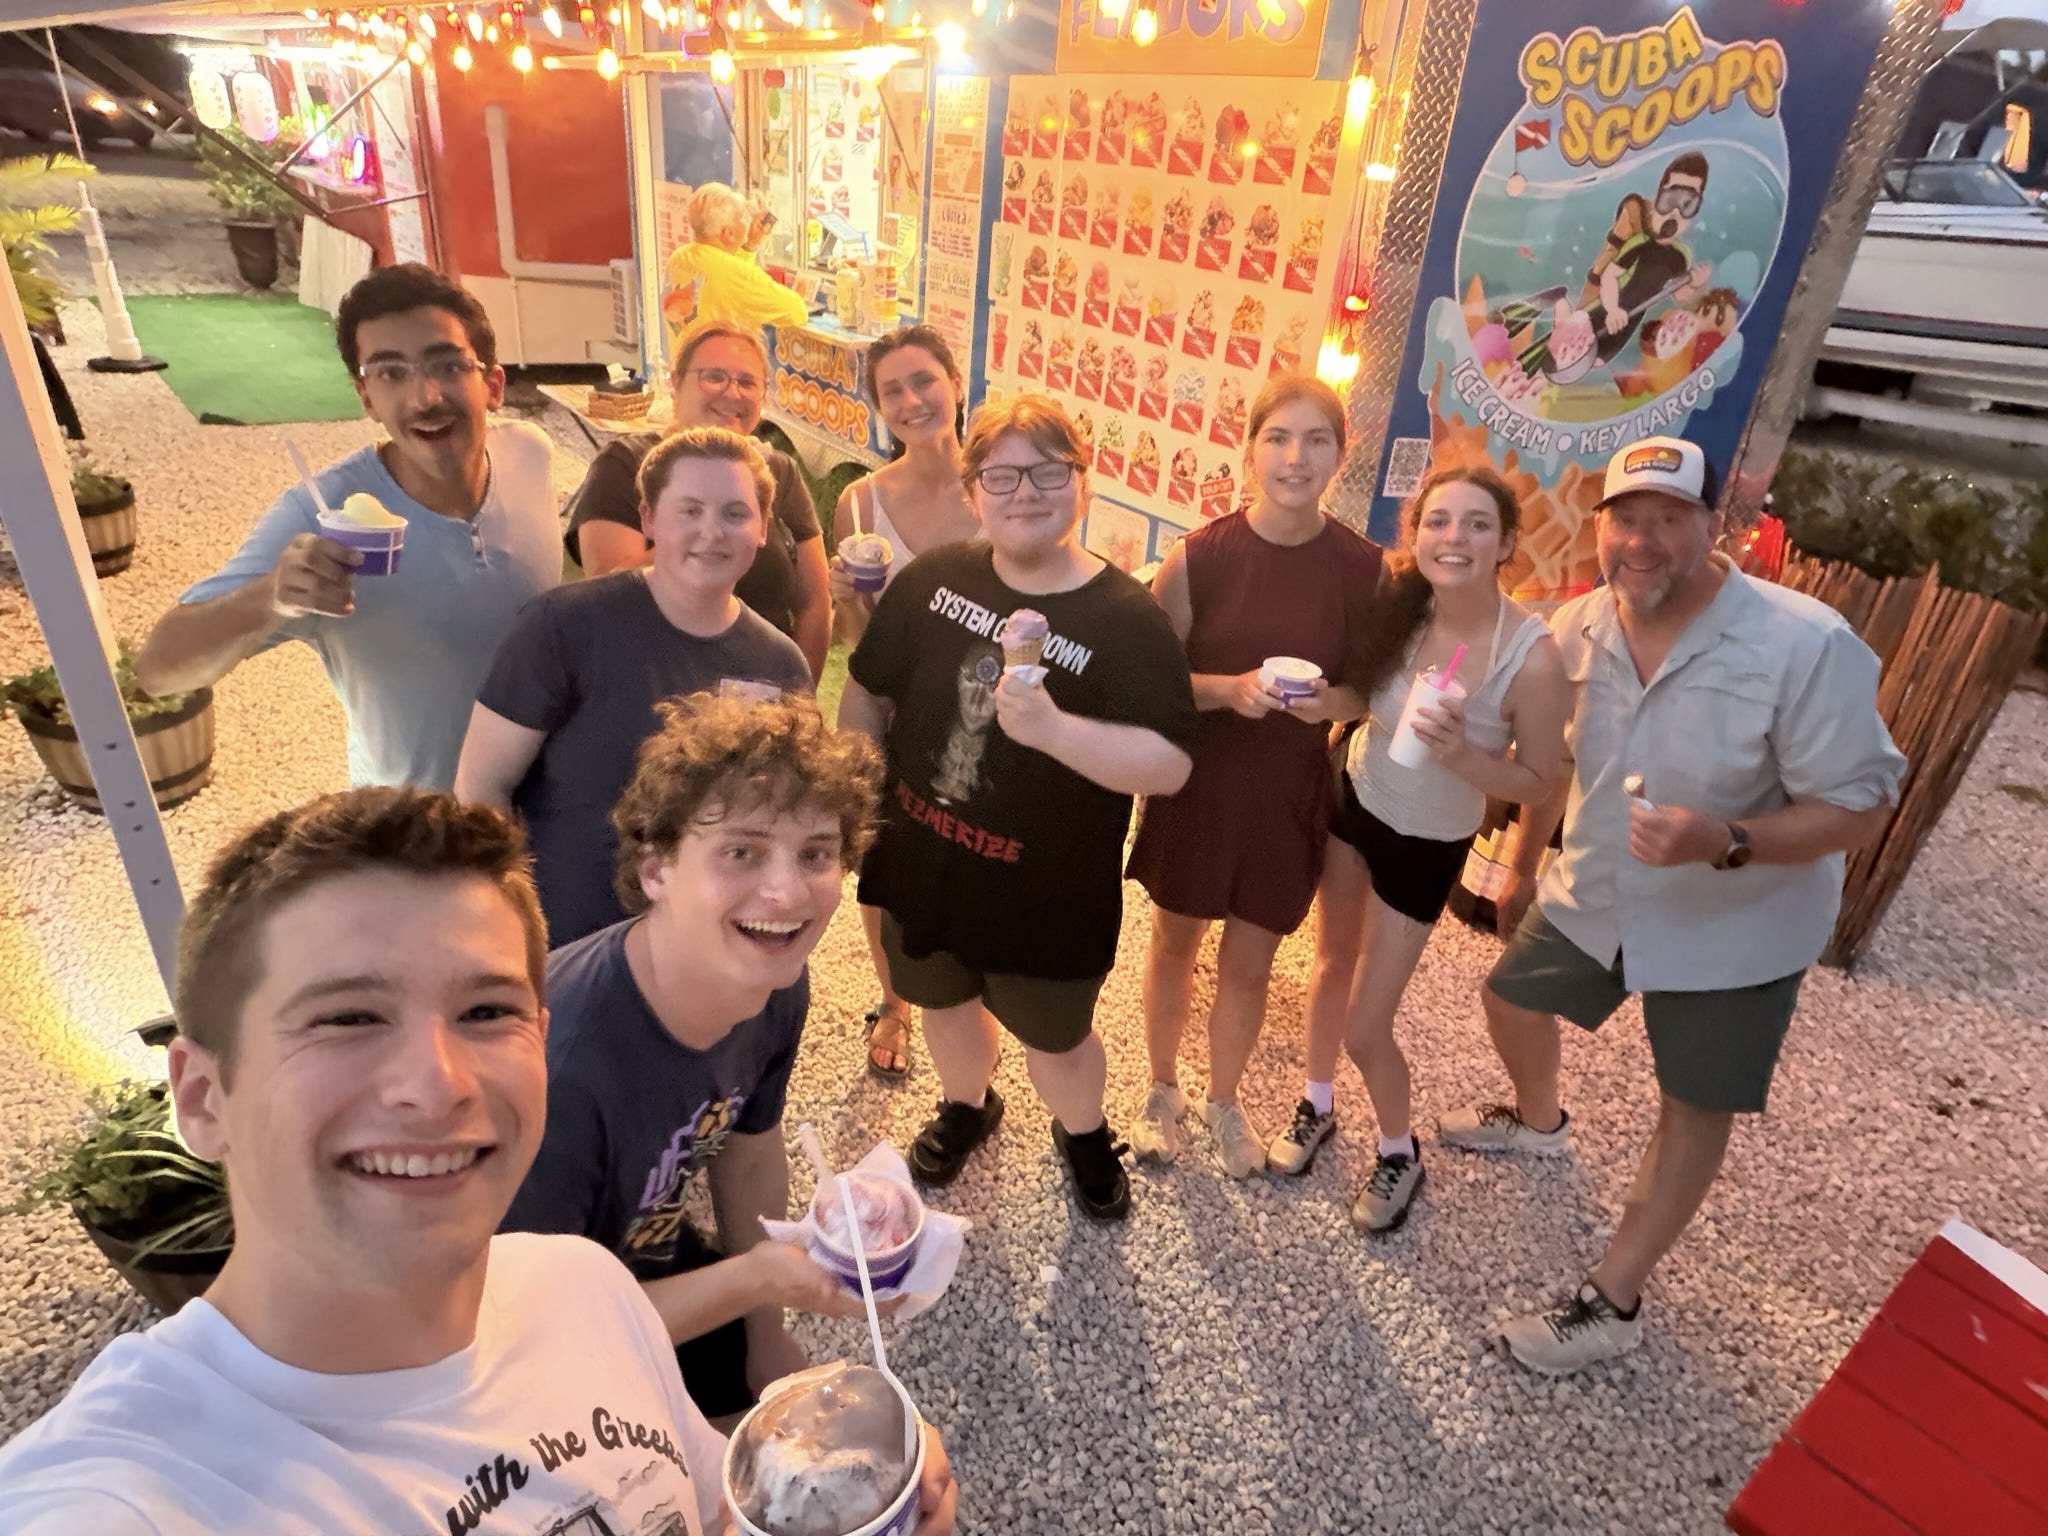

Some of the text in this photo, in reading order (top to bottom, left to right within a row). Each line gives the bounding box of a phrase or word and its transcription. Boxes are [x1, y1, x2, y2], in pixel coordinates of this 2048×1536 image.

[1522, 10, 1703, 107] SCUBA
[1560, 45, 1785, 166] SCOOPS
[775, 328, 855, 392] SCUBA
[776, 369, 869, 446] SCOOPS
[1450, 357, 1715, 455] ICE CREAM KEY LARGO
[929, 587, 997, 637] SYSTEM
[446, 1454, 529, 1536] with
[529, 1431, 586, 1472] the
